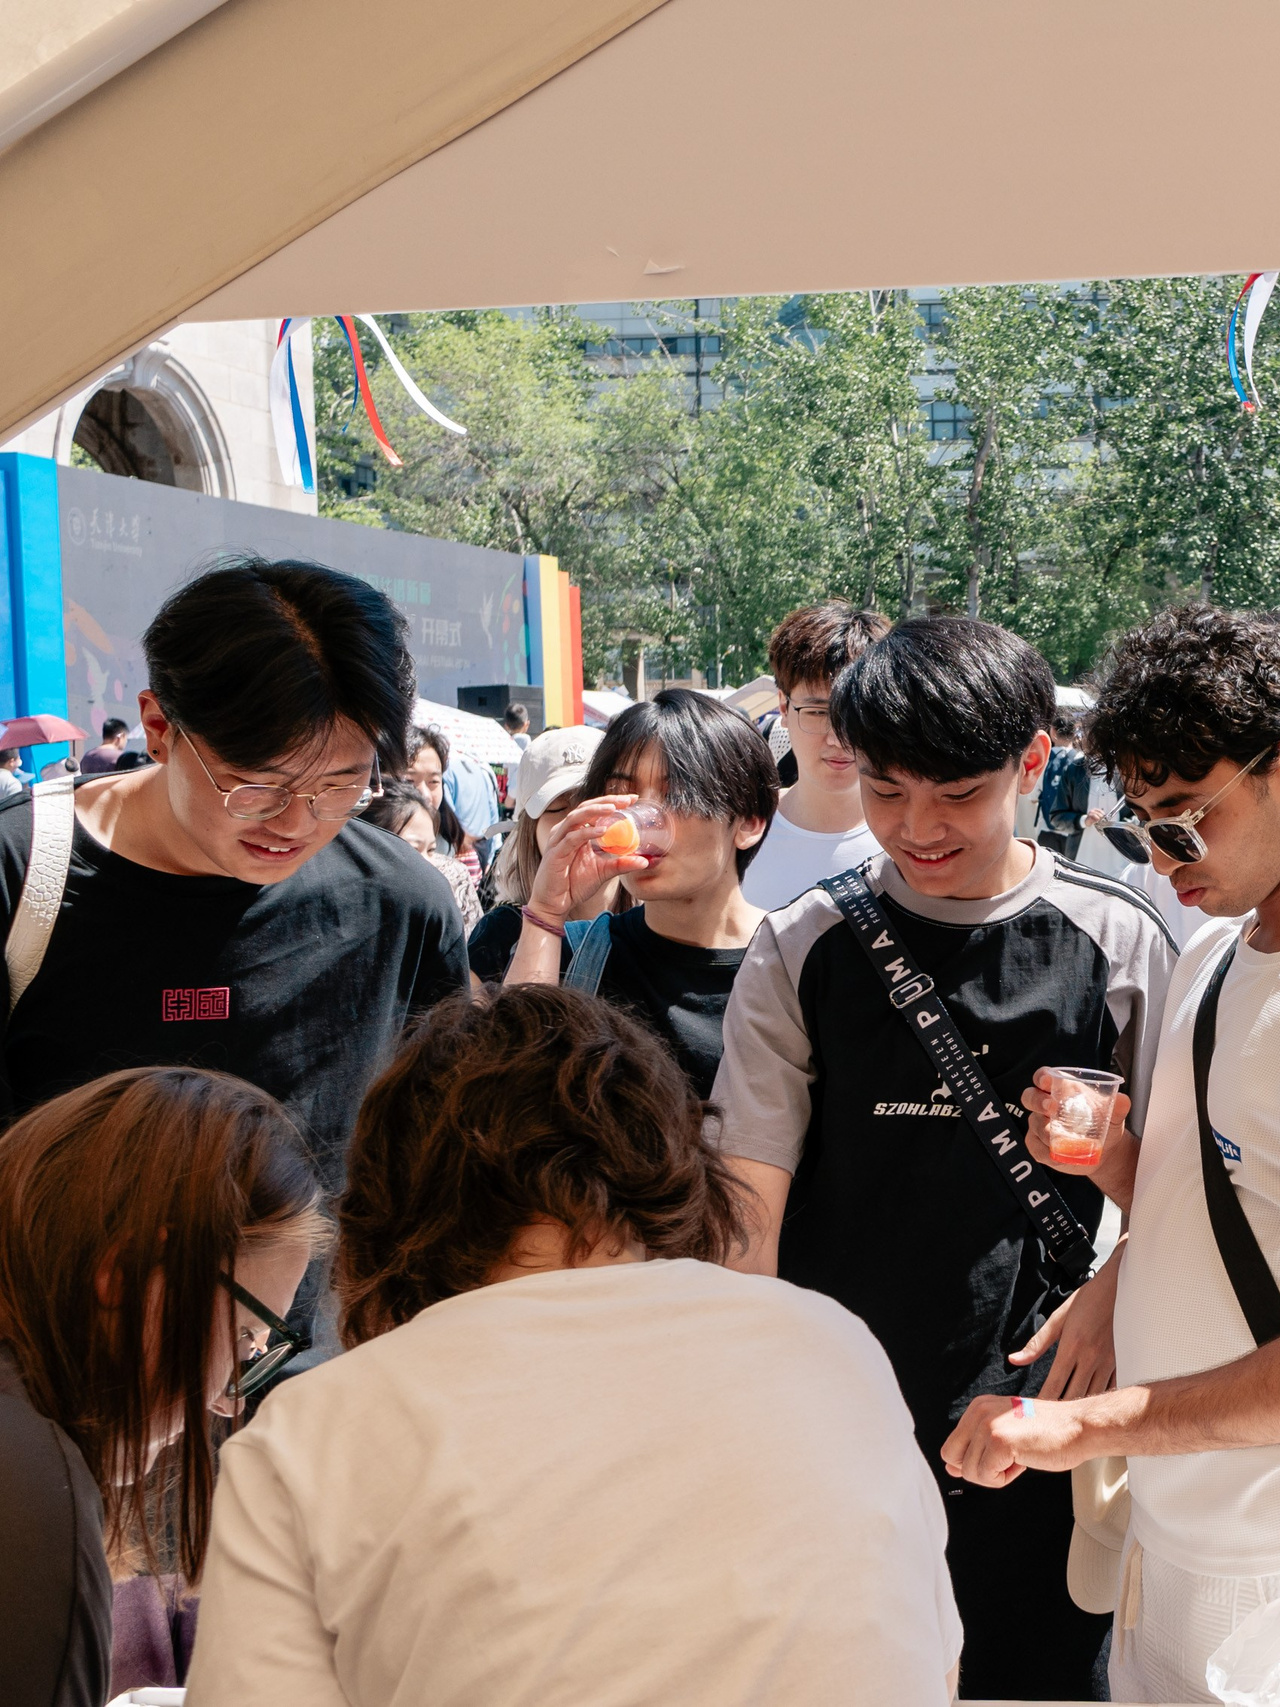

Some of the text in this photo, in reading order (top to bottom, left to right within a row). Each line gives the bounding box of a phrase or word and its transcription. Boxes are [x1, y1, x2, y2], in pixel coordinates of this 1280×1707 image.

[832, 881, 868, 931] NINETEEN
[860, 897, 881, 924] FORTY
[871, 929, 941, 1029] PUMA
[930, 1038, 974, 1103] NINETEEN
[942, 1031, 986, 1096] FORTY EIGHT
[976, 1101, 1051, 1209] PUMA
[1052, 1208, 1074, 1236] EIGHT
